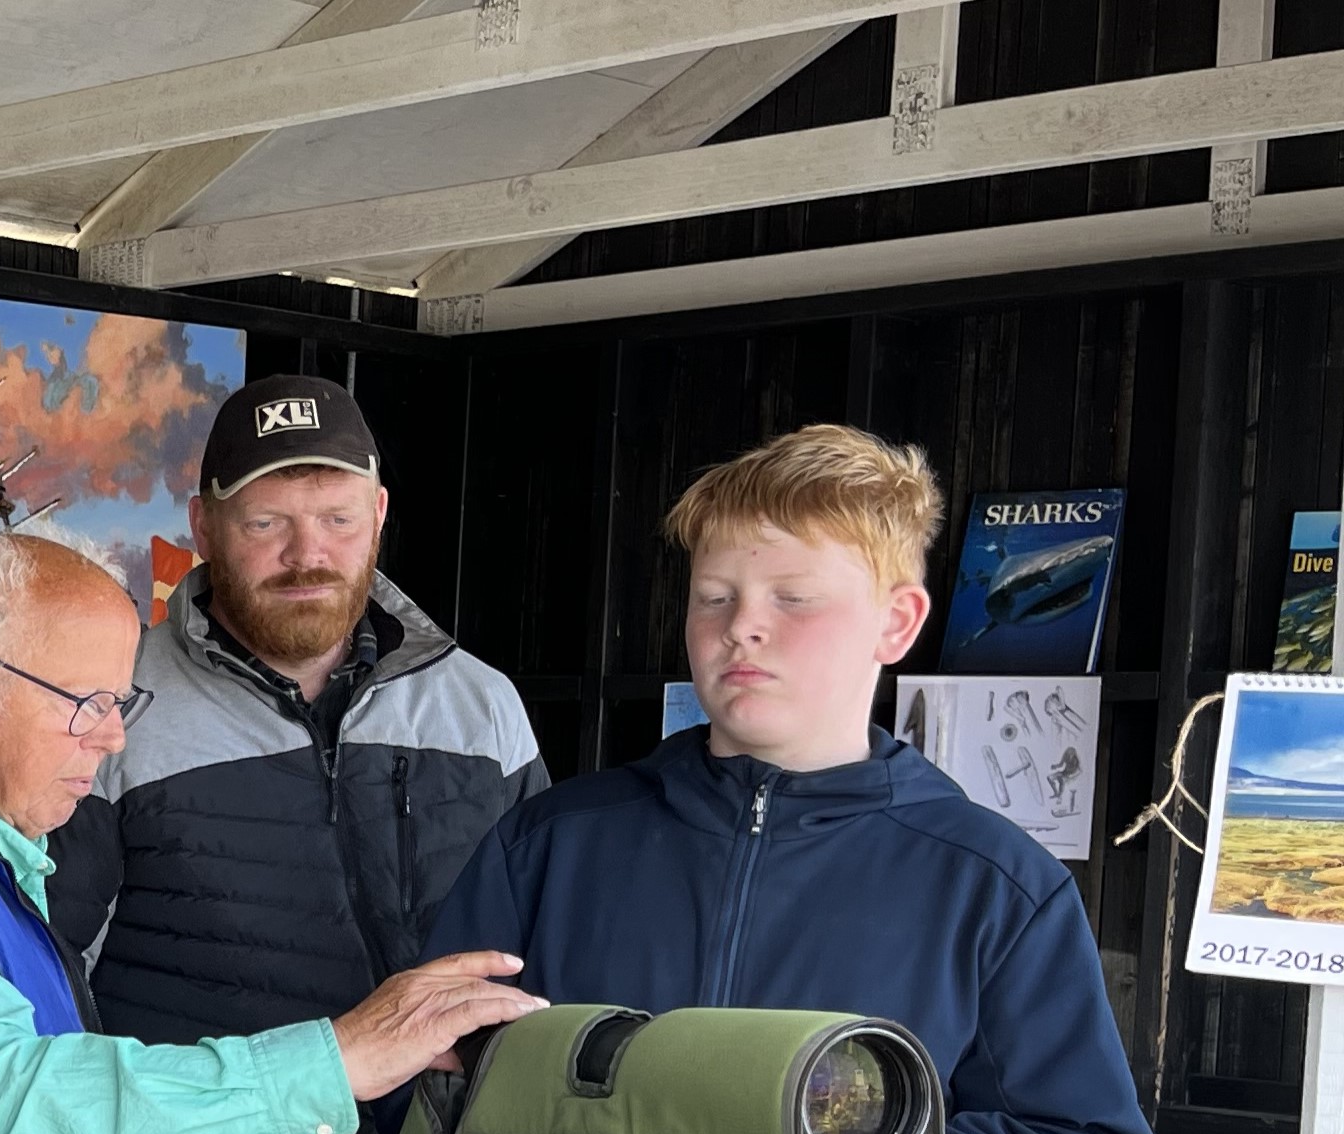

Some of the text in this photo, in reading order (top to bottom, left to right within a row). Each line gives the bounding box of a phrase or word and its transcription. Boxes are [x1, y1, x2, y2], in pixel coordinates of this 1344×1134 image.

[262, 402, 313, 432] XL
[984, 501, 1103, 527] SHARKS
[1293, 553, 1334, 573] Dive
[1200, 941, 1344, 974] 2017-2018
